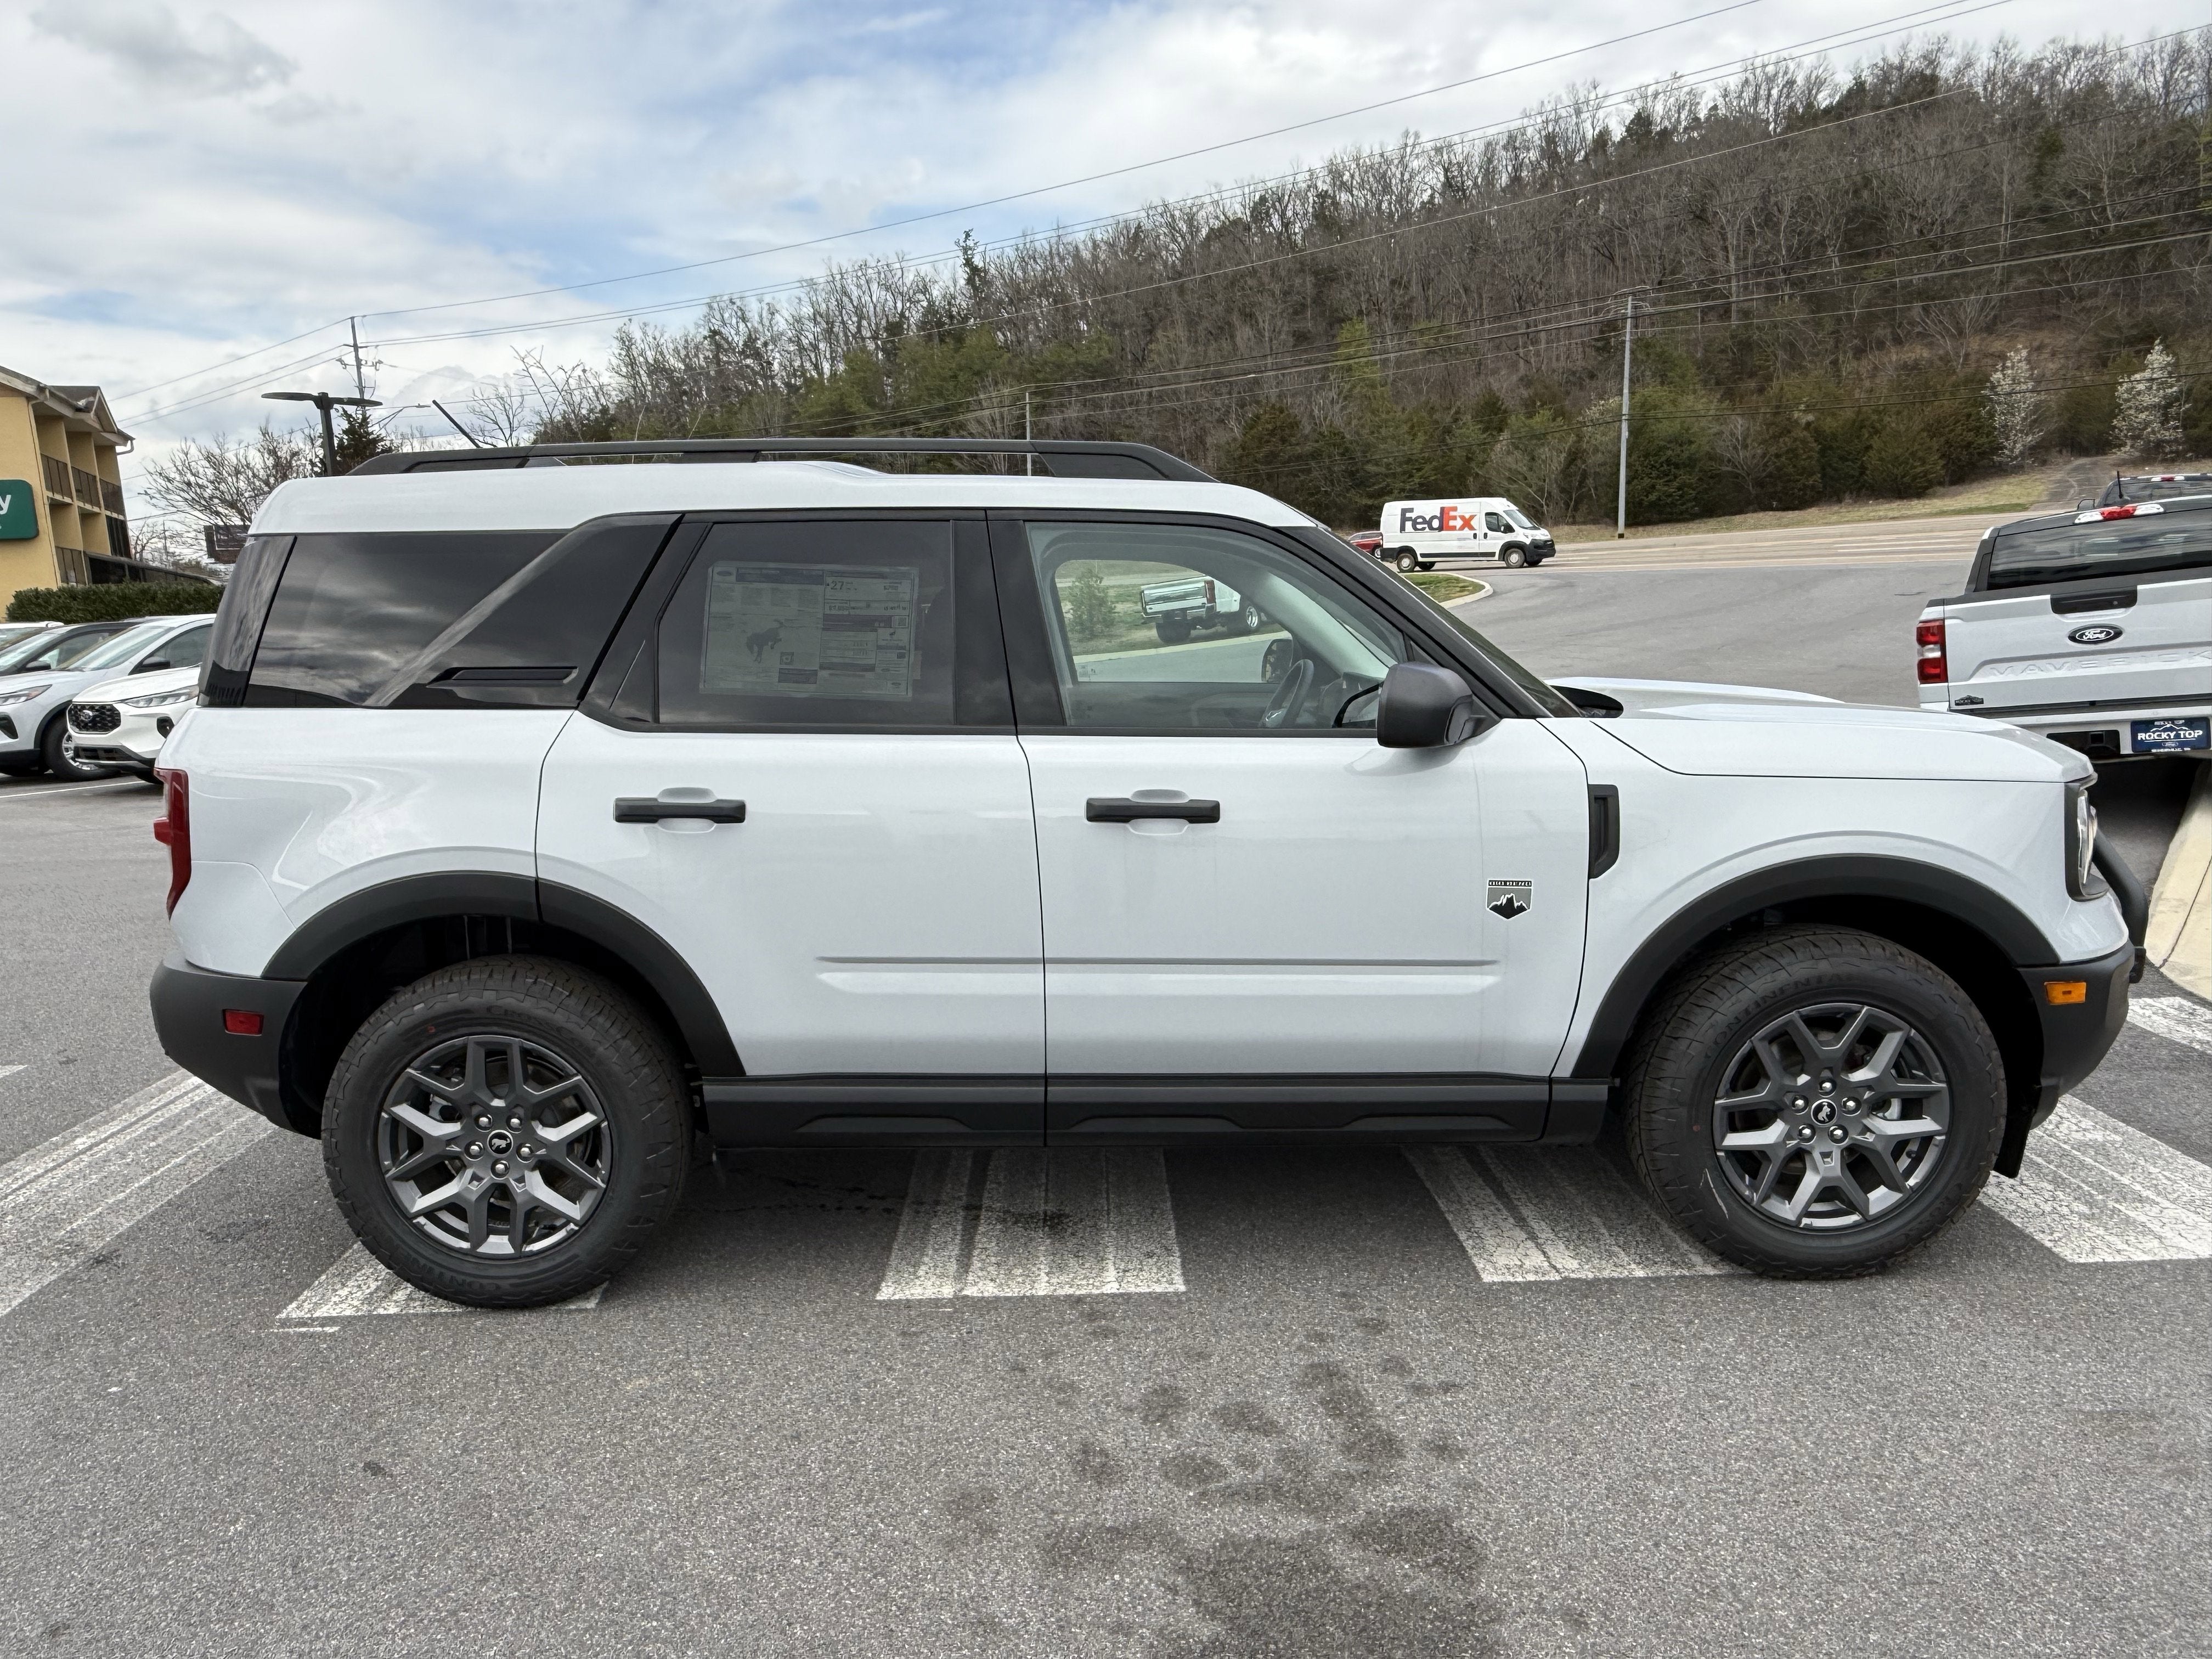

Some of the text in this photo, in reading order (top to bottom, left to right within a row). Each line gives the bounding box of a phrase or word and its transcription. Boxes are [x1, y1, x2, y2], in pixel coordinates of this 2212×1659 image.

[1400, 505, 1477, 533] FedEx
[2137, 730, 2203, 740] ROCKY TOP
